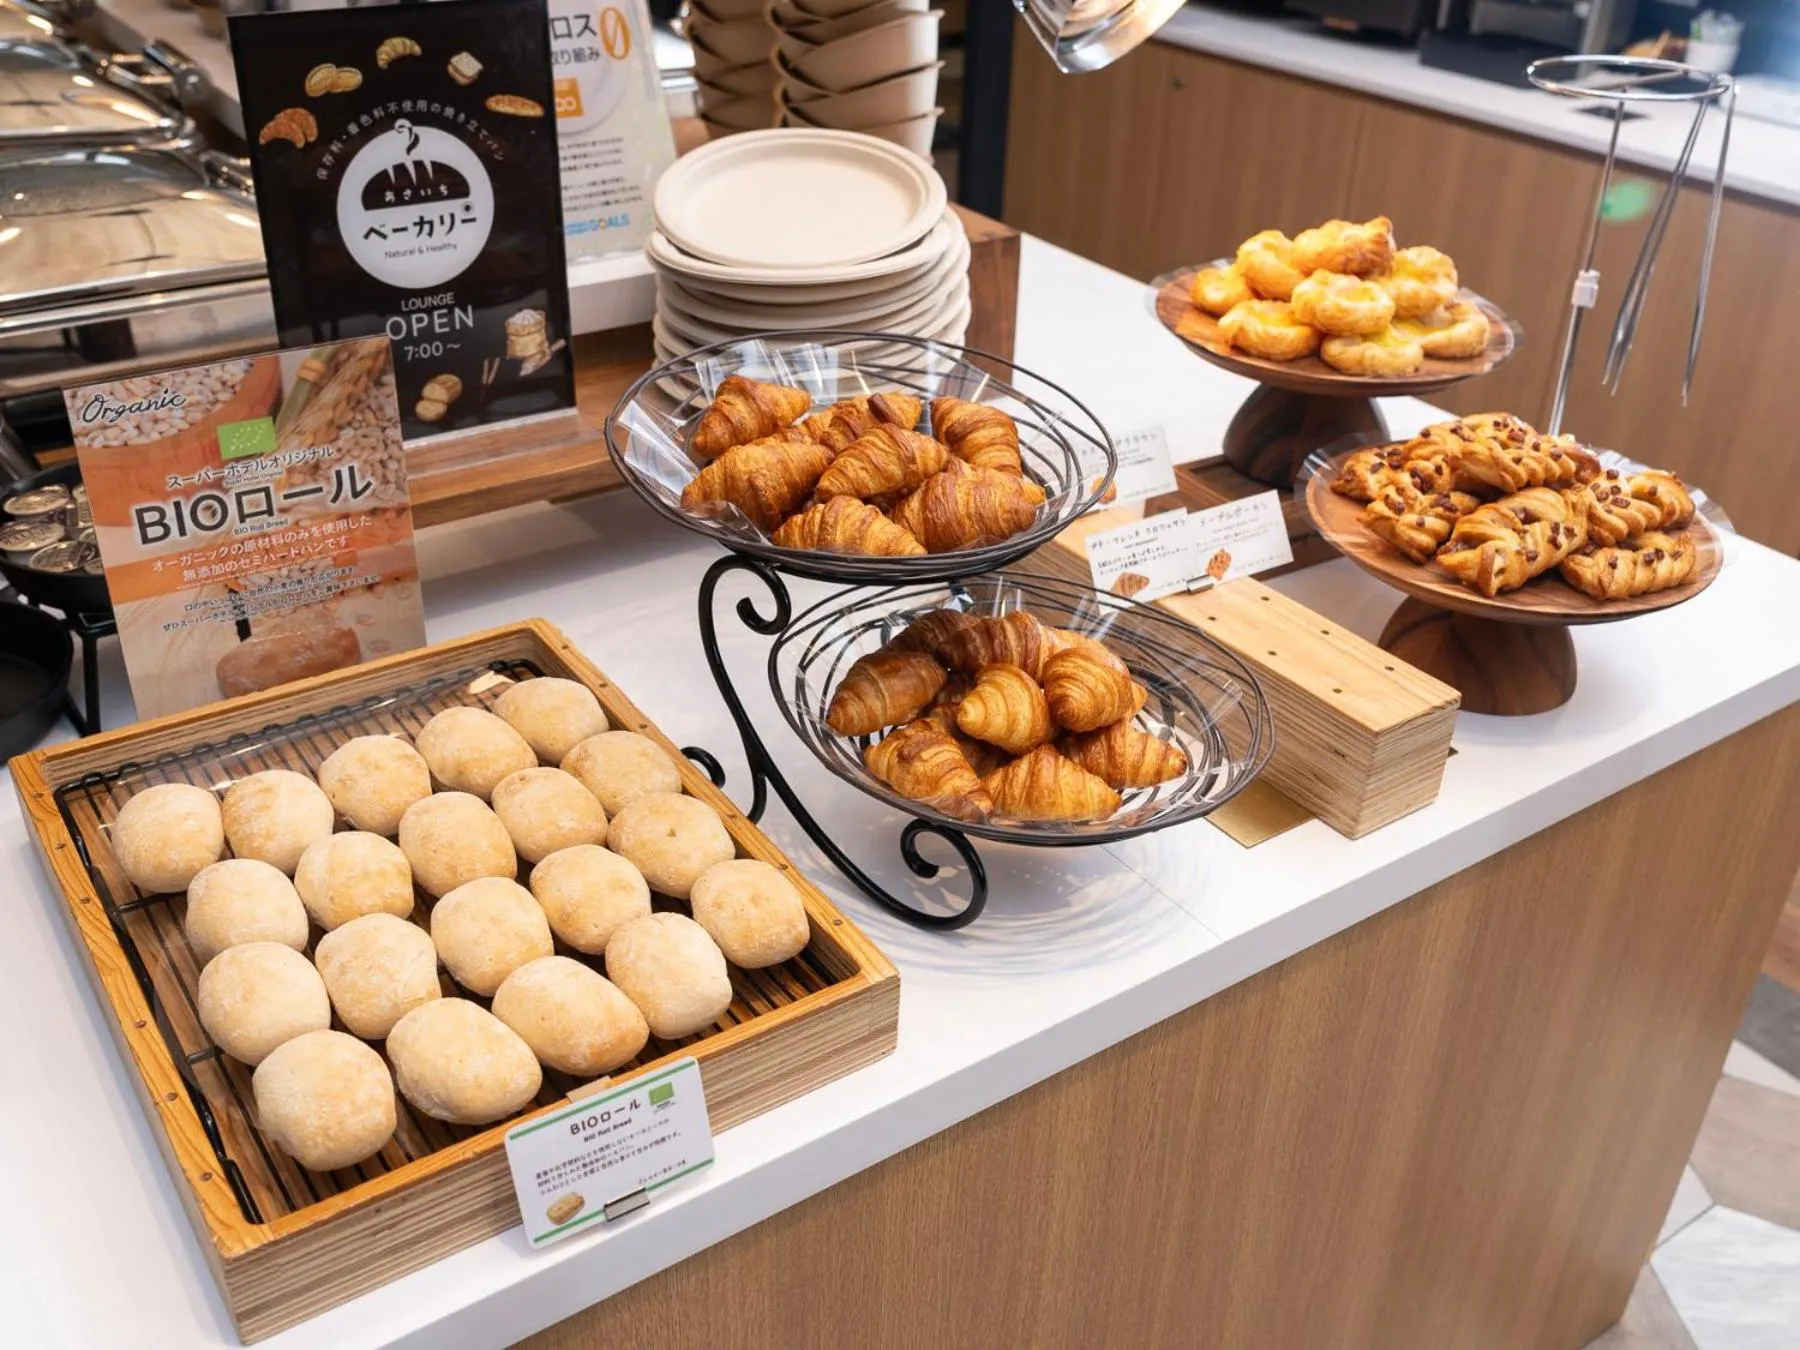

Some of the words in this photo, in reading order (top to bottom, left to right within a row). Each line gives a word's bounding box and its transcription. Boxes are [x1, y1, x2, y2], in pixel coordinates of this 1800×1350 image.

[384, 184, 449, 203] あさいち
[362, 212, 477, 241] ベーカリー
[384, 245, 415, 259] Natural
[417, 245, 424, 255] &
[426, 242, 458, 254] Healthy
[401, 292, 455, 312] LOUNGE
[385, 303, 475, 341] OPEN
[81, 387, 187, 425] Organic
[166, 446, 334, 489] スーパーホテルオリジナル
[133, 464, 374, 547] BIOロール
[266, 517, 289, 529] Bread
[151, 514, 374, 573] オーガニックの原材料のみを使用した
[182, 534, 351, 583] 無添加のセミハードパンです
[569, 1099, 642, 1137] BIOロール
[612, 1117, 633, 1132] Bread
